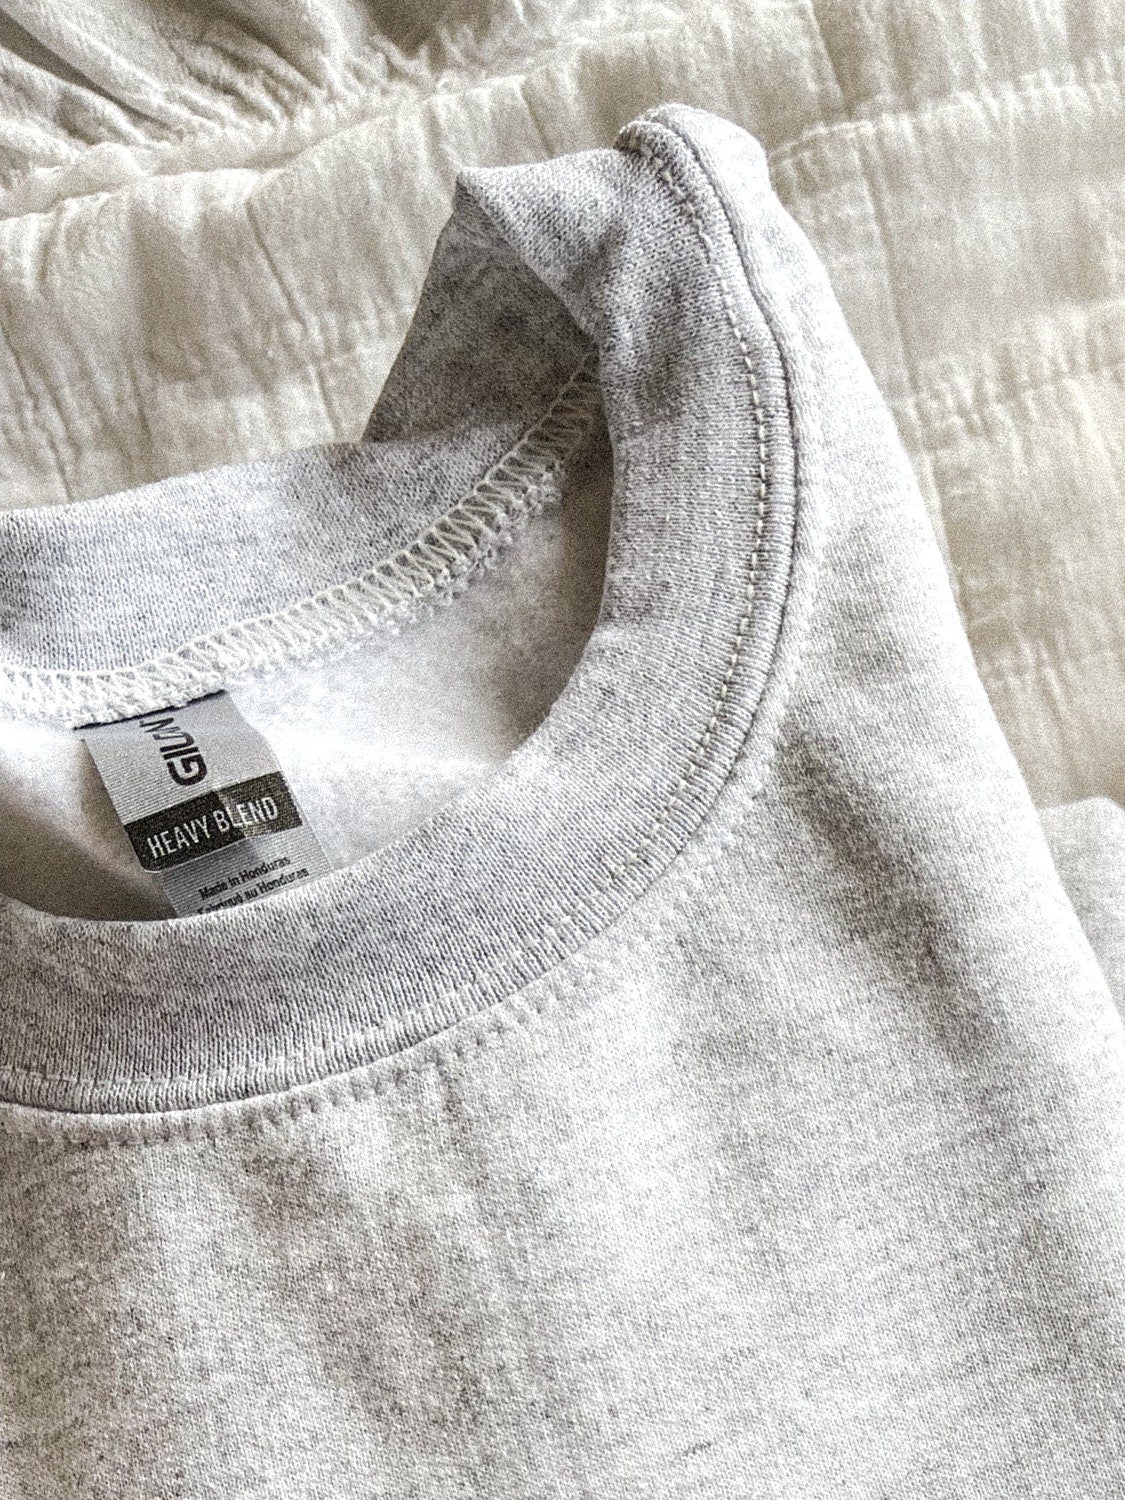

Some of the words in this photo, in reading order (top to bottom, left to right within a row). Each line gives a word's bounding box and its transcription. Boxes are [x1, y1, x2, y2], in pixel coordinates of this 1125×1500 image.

[146, 815, 211, 859] HEAVY
[212, 796, 278, 833] BLEND
[198, 881, 229, 901] Made
[228, 874, 241, 888] in
[239, 856, 292, 884] Honduras
[244, 887, 259, 901] au
[258, 867, 310, 896] Honduras
